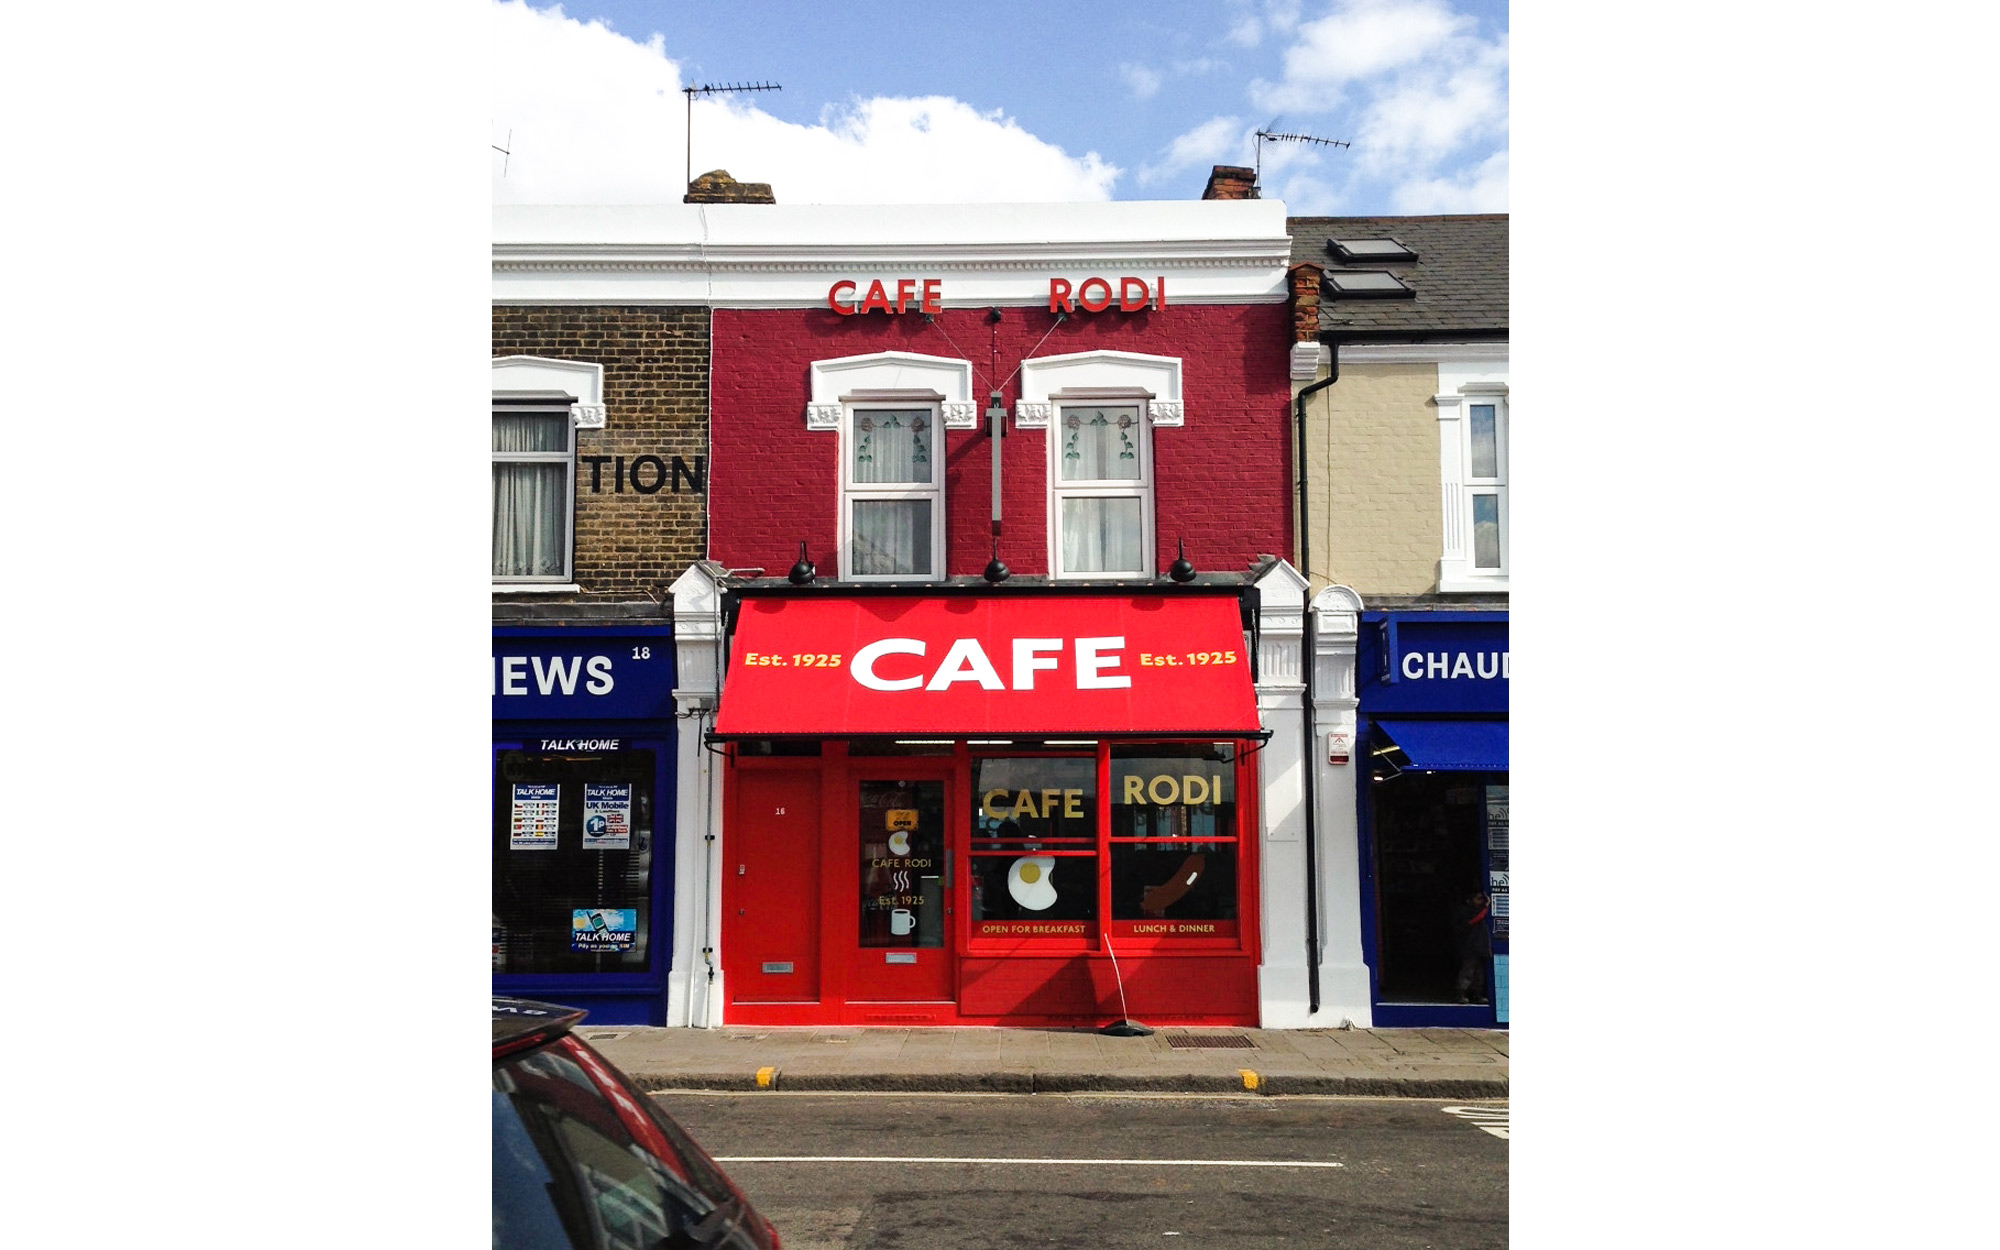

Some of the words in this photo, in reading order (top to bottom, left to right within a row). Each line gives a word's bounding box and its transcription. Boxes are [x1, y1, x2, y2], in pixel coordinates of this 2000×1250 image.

[828, 279, 942, 315] CAFE
[1050, 276, 1165, 313] RODI
[581, 455, 703, 494] TION
[631, 647, 650, 659] 18
[1140, 653, 1182, 666] Est.
[1186, 651, 1237, 666] 1925
[745, 653, 788, 667] Est.
[792, 654, 843, 668] 1925
[850, 636, 1132, 691] CAFE
[492, 656, 614, 695] EWS
[541, 739, 576, 750] TALK
[577, 739, 619, 750] HOME
[535, 788, 556, 796] HOME
[1124, 774, 1221, 805] RODI
[586, 801, 600, 809] UK
[601, 801, 629, 809] Mobile
[983, 788, 1085, 819] CAFE
[872, 859, 900, 868] CAFE
[904, 859, 931, 868] RODI
[879, 896, 899, 905] Est.
[901, 896, 925, 905] 1925
[982, 925, 1008, 933] OPEN
[1012, 925, 1031, 933] FOR
[1033, 925, 1086, 933] BREAKFAST
[1133, 925, 1167, 933] LUNCH
[1170, 925, 1176, 933] &
[1179, 925, 1215, 933] DINNER
[575, 933, 599, 942] TALK
[601, 933, 631, 942] HOME
